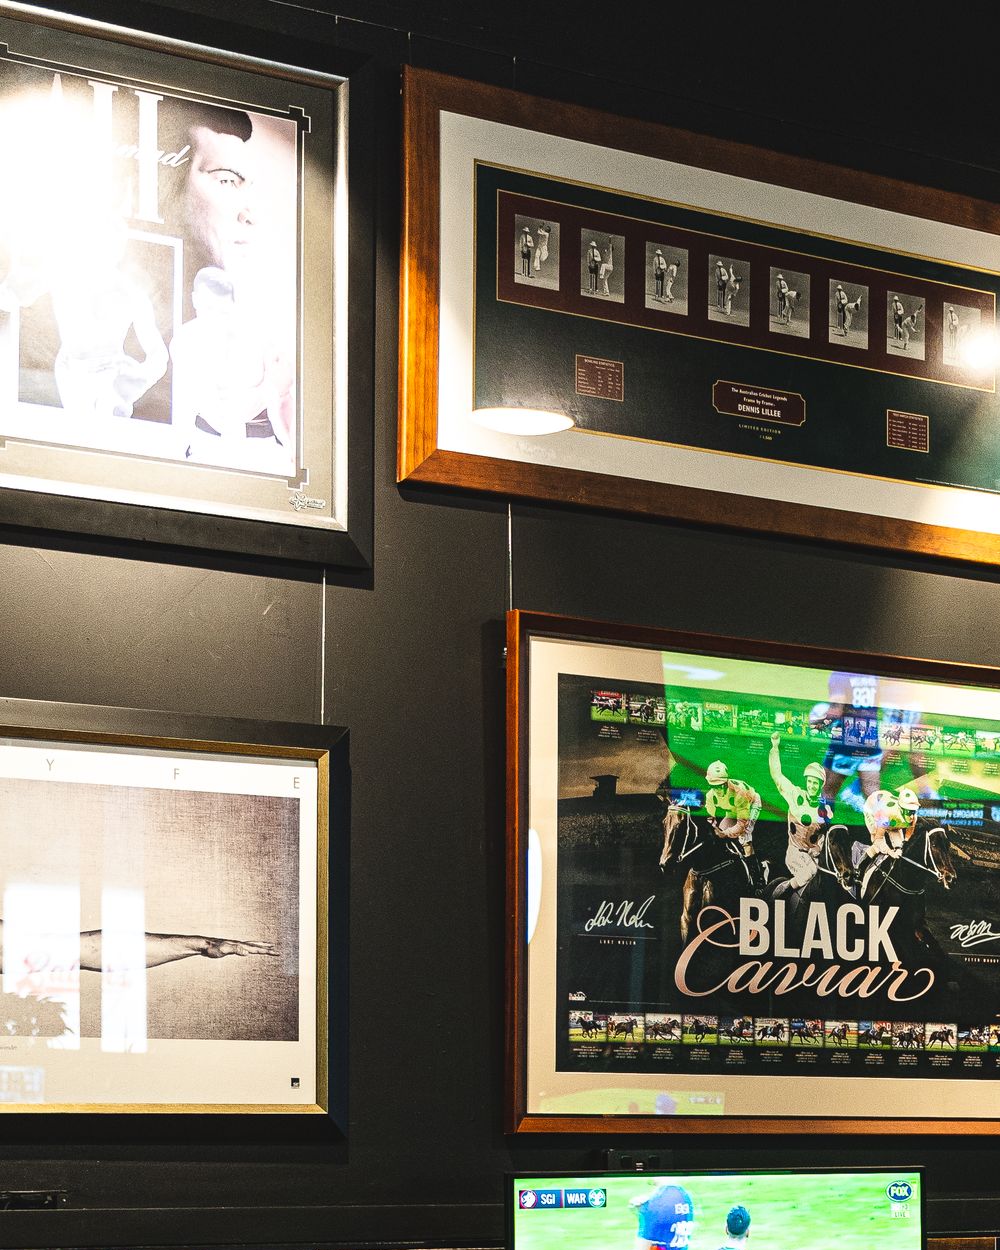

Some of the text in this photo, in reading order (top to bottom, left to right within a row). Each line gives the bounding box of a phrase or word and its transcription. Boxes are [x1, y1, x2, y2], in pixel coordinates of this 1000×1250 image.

[737, 403, 781, 418] DENNIS LILLEE
[46, 758, 301, 789] Y F E
[739, 897, 900, 963] BLACK
[674, 905, 935, 1002] Caviar
[566, 1193, 586, 1204] WAR
[890, 1185, 909, 1197] FOX
[540, 1193, 555, 1205] SGI
